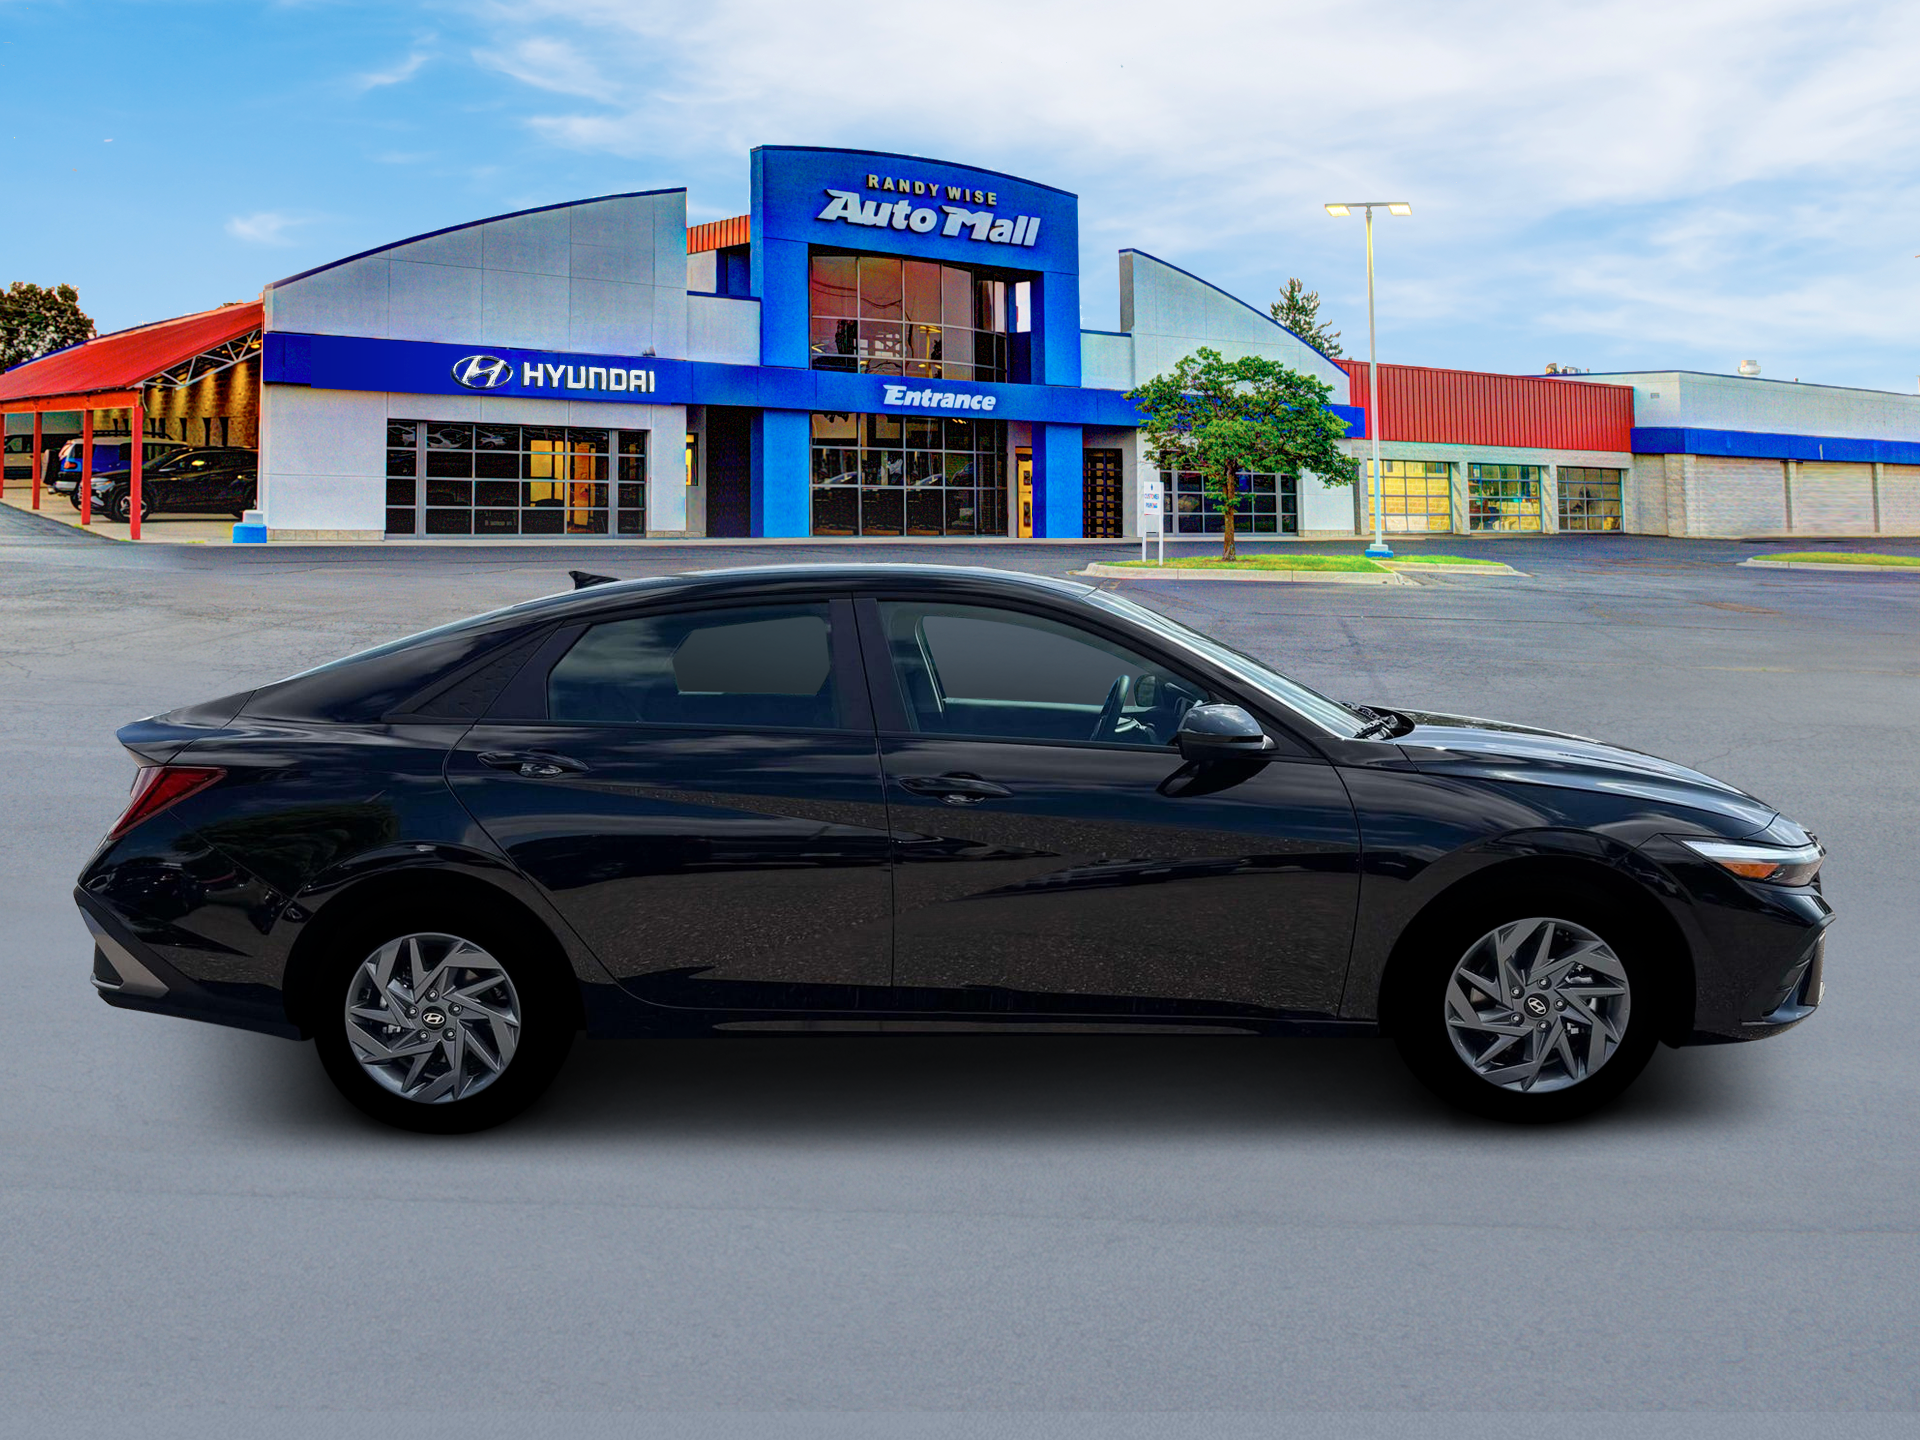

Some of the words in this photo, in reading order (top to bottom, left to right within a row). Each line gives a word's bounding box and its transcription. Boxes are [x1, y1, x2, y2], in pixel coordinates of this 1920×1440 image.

[867, 174, 939, 197] RANDY
[946, 186, 997, 205] WISE
[817, 188, 937, 233] Auto
[941, 205, 1041, 247] Mall
[522, 361, 655, 393] HYUNDAI
[882, 384, 997, 411] Entrance
